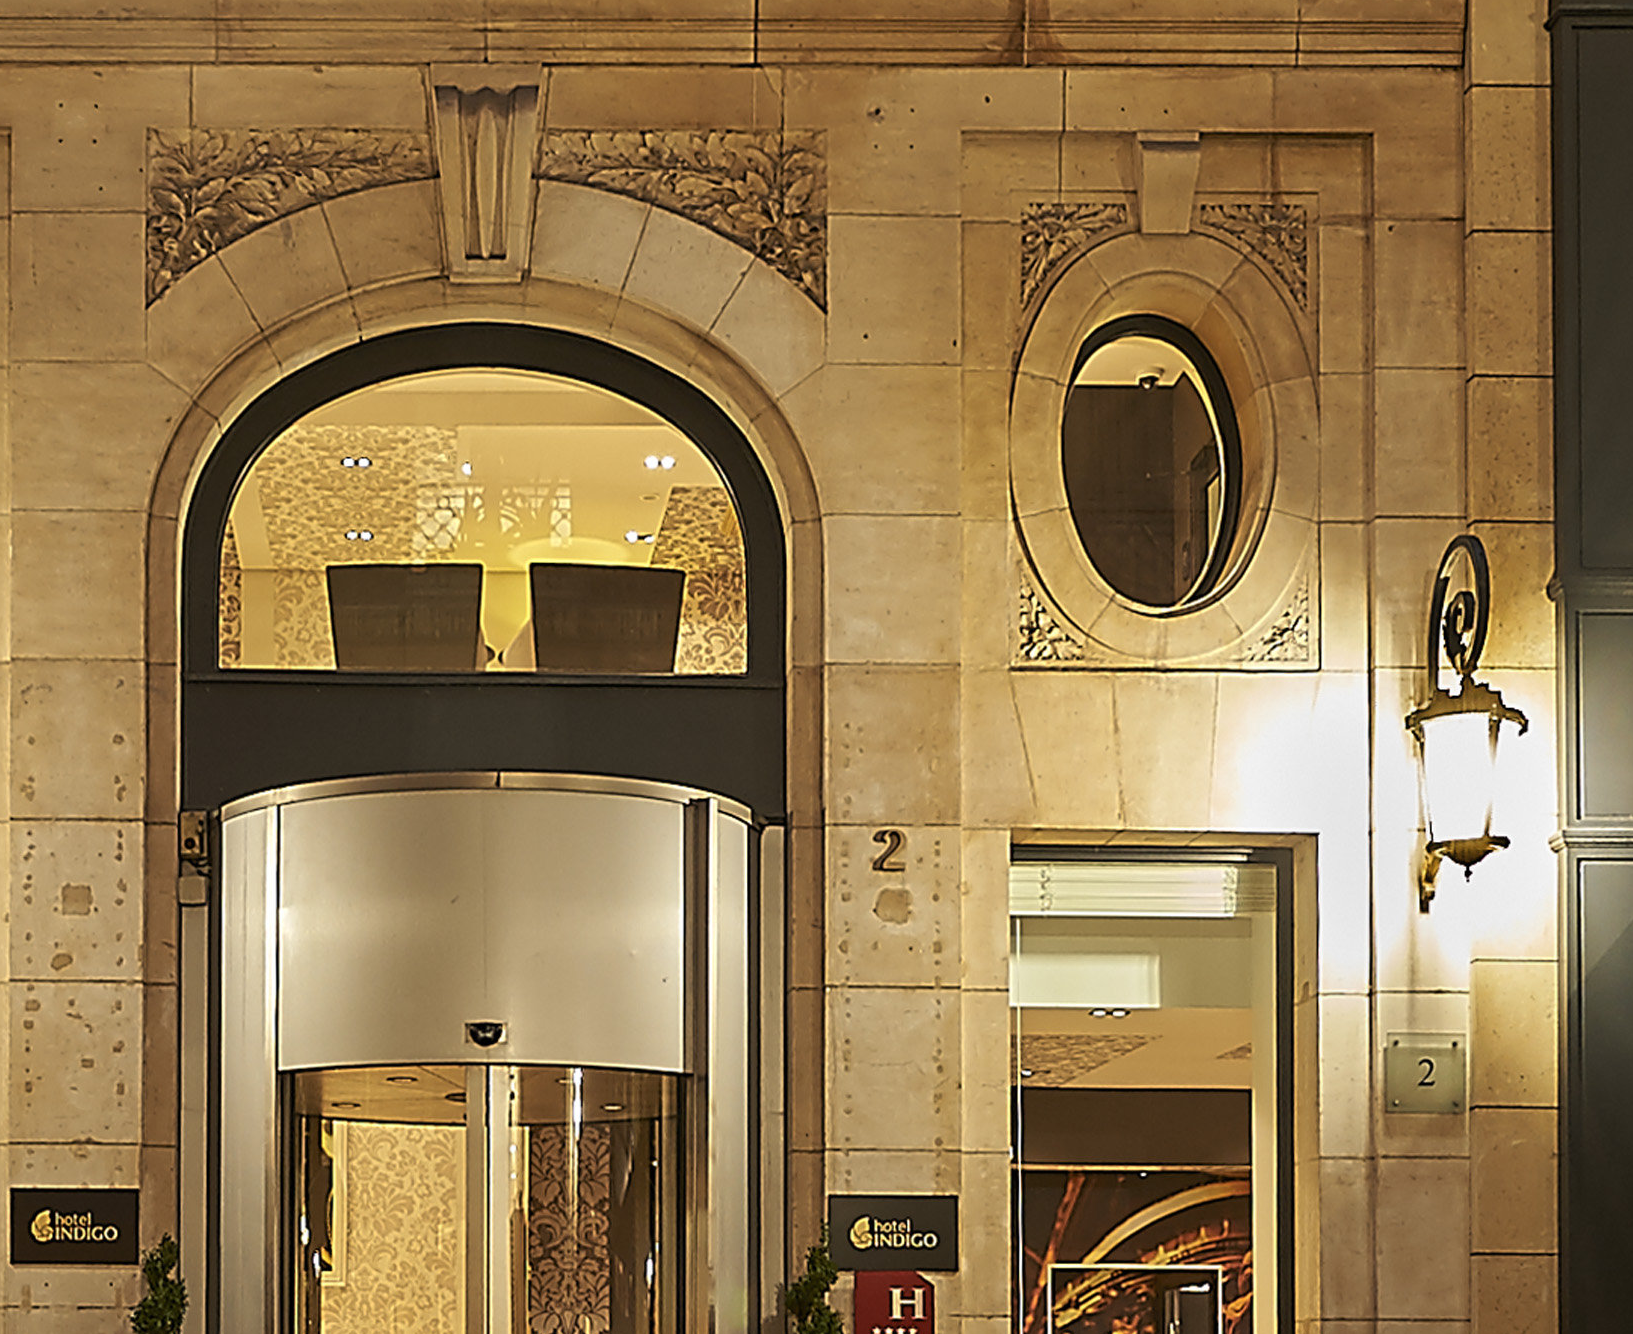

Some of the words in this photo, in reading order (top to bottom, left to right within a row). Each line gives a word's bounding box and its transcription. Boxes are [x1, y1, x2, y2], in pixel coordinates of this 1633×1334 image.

[872, 829, 906, 872] 2
[1417, 1058, 1436, 1087] 2
[55, 1211, 92, 1226] hotel
[873, 1218, 911, 1233] hotel
[55, 1226, 119, 1241] INDIGO
[874, 1232, 938, 1248] INDIGO
[888, 1287, 928, 1320] H
